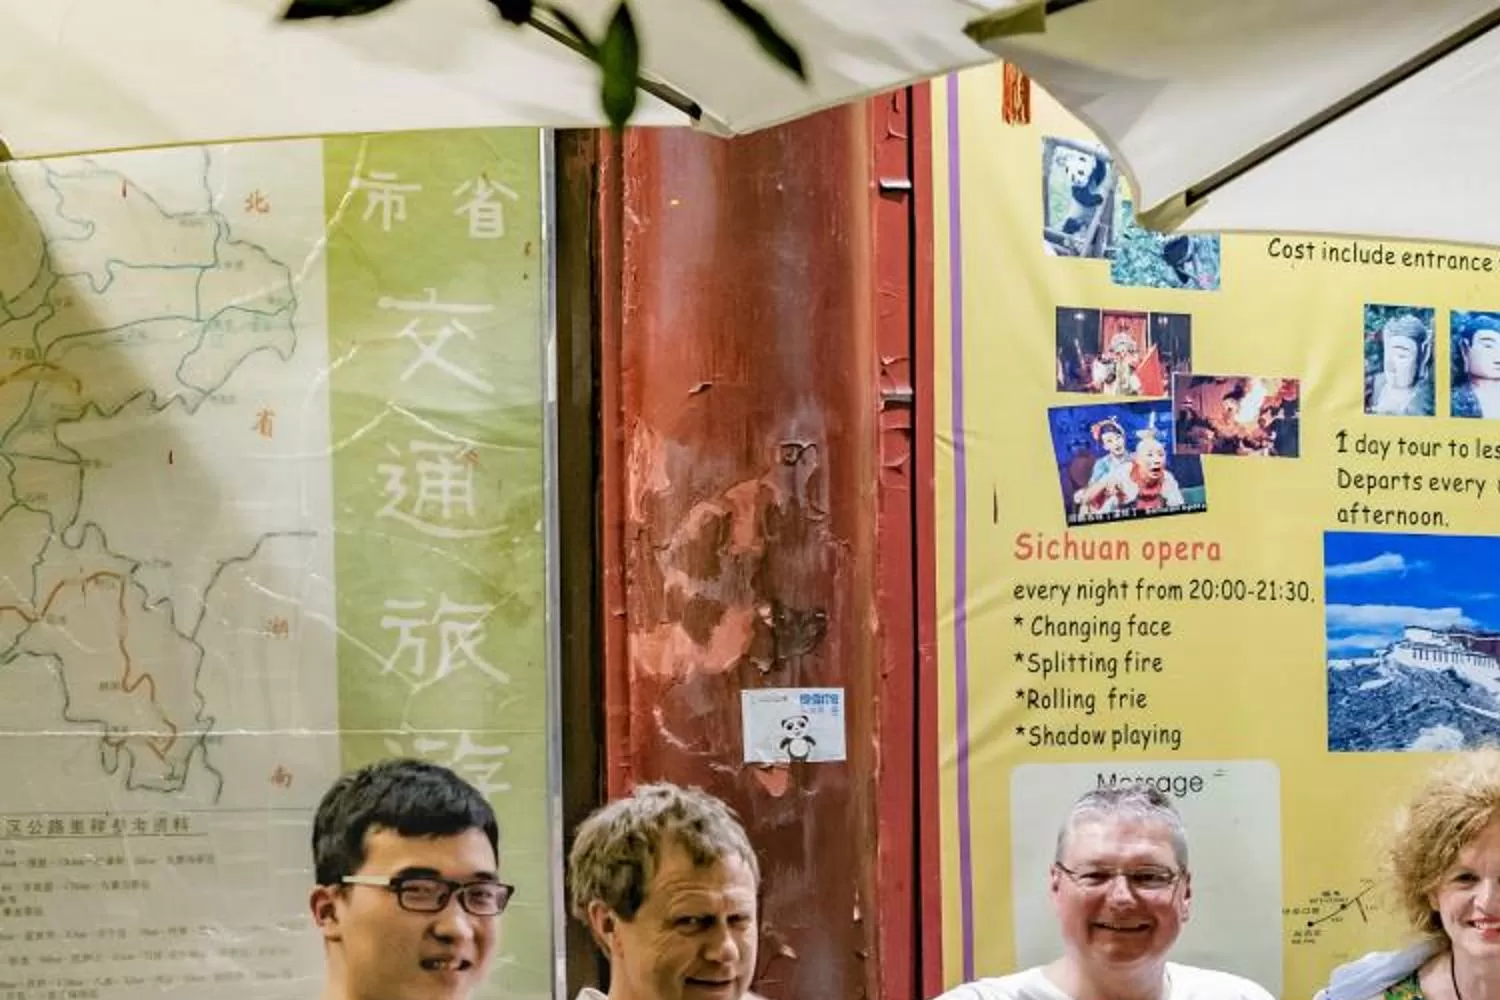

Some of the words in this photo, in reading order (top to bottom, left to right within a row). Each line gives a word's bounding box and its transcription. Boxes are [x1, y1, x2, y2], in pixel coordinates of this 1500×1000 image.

[1267, 238, 1315, 260] Cost
[1322, 241, 1396, 266] include
[1402, 250, 1493, 273] entrance
[1355, 433, 1391, 461] day
[1398, 438, 1441, 459] tour
[1449, 441, 1469, 460] to
[1337, 467, 1422, 494] Departs
[1428, 475, 1486, 499] every
[1337, 502, 1450, 528] afternoon.
[1013, 533, 1130, 563] Sichuan
[1142, 538, 1222, 569] opera
[1013, 580, 1071, 606] every
[1077, 579, 1129, 606] night
[1135, 578, 1184, 600] from
[1188, 579, 1315, 603] 20:00-21:30.
[1030, 614, 1122, 642] Changing
[1127, 613, 1172, 637] face
[1124, 650, 1164, 675] fire
[1107, 687, 1148, 710] frie
[1111, 723, 1182, 752] playing
